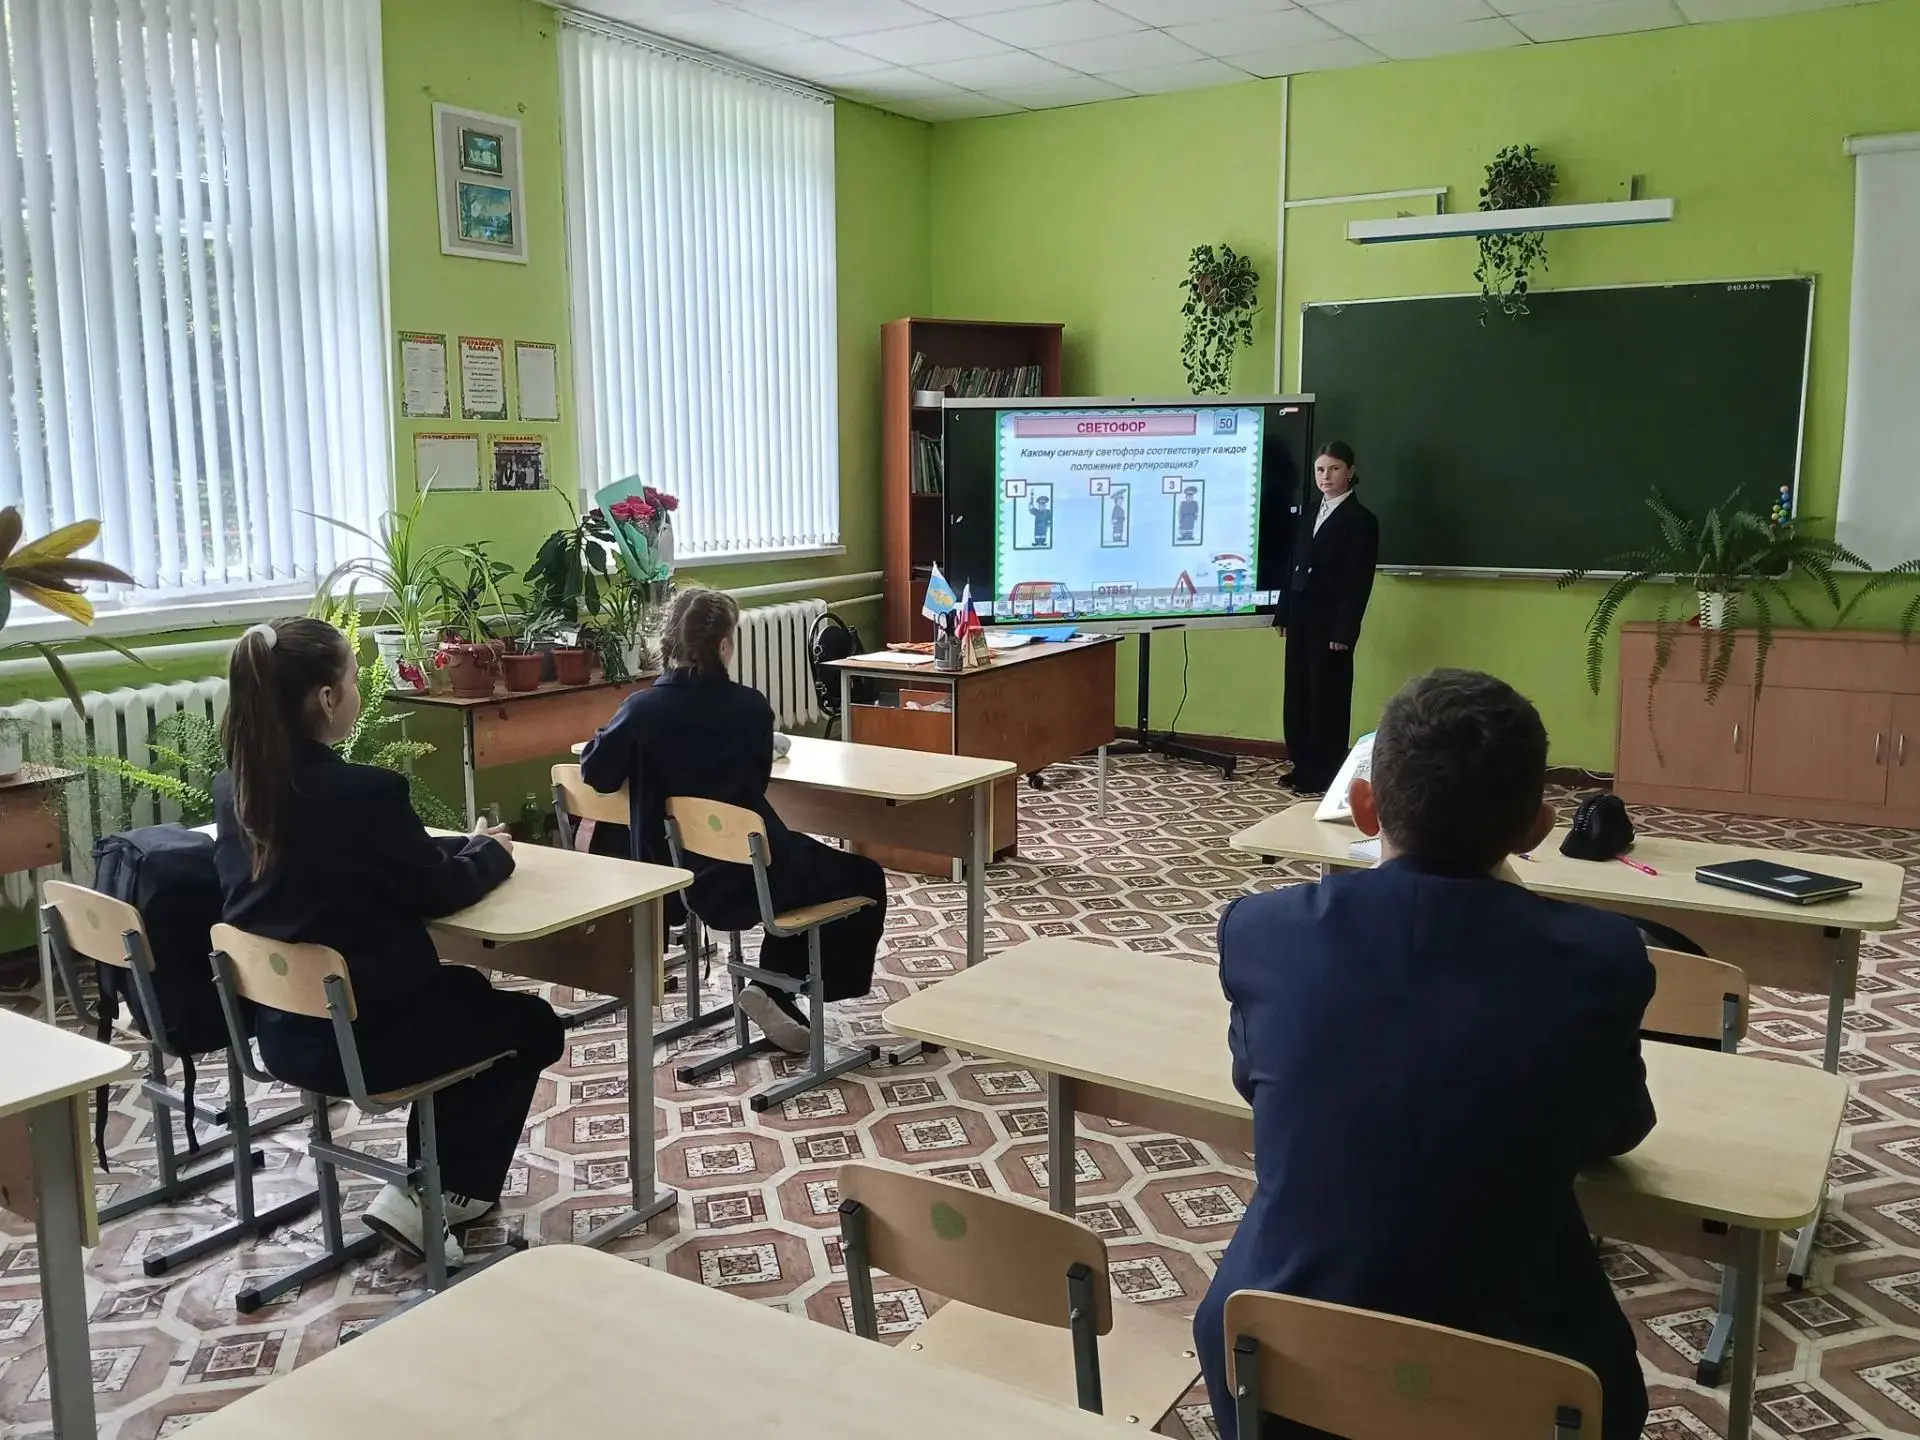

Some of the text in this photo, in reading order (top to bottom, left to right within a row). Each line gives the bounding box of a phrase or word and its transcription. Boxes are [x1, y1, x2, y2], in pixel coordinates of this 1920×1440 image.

[1077, 422, 1146, 433] СВЕТОФОР
[1220, 418, 1232, 429] 50
[1021, 445, 1246, 458] Какому сигналу светофора соответствует каждое
[1070, 460, 1198, 471] положение регулировщика?
[1013, 484, 1018, 493] 1
[1097, 483, 1103, 492] 2
[1169, 481, 1175, 490] 3
[1097, 584, 1132, 595] ОТВЕТ
